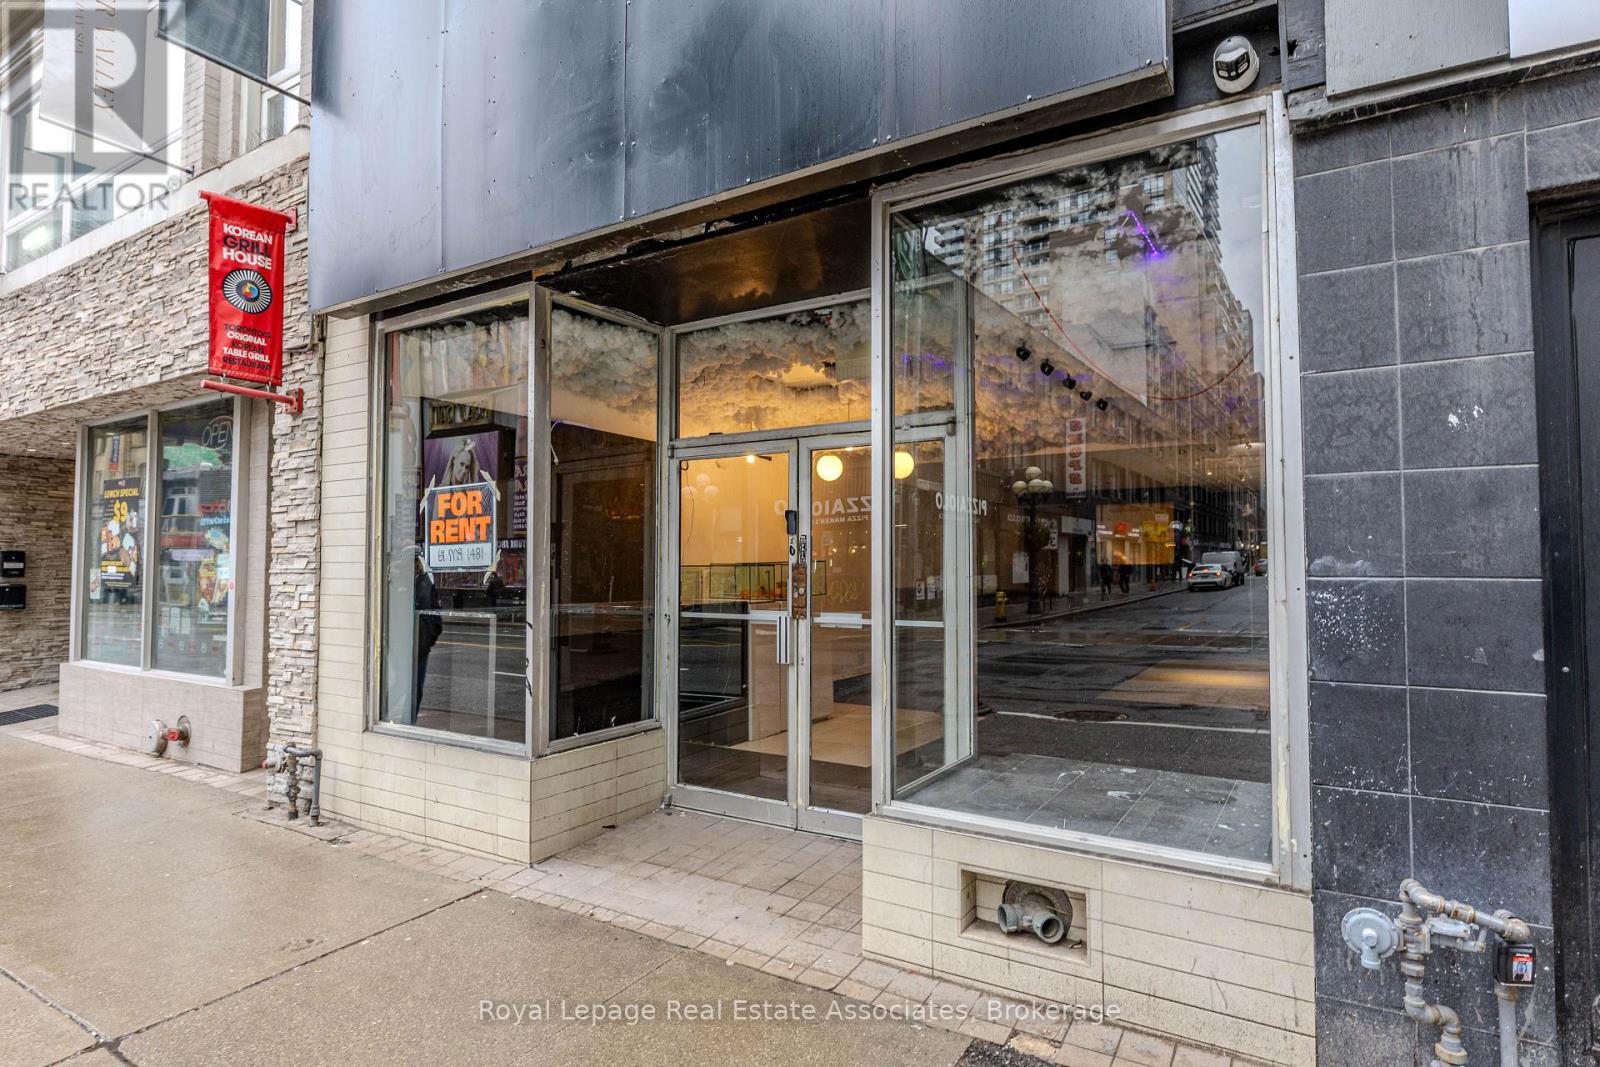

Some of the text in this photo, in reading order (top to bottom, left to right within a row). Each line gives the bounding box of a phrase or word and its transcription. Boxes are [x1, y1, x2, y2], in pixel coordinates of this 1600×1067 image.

[223, 223, 273, 245] KOREAN
[223, 235, 271, 258] GRILL
[222, 247, 272, 270] HOUSE
[226, 331, 267, 346] ORIGINAL
[231, 340, 264, 354] KOREAN
[222, 346, 271, 363] TABLE GRILL
[222, 356, 272, 370] RESTAURANT
[202, 420, 233, 446] OPEN
[104, 487, 139, 498] LUNCH SPECIAL
[437, 489, 483, 518] FOR
[113, 499, 129, 524] $9
[430, 515, 492, 545] RENT
